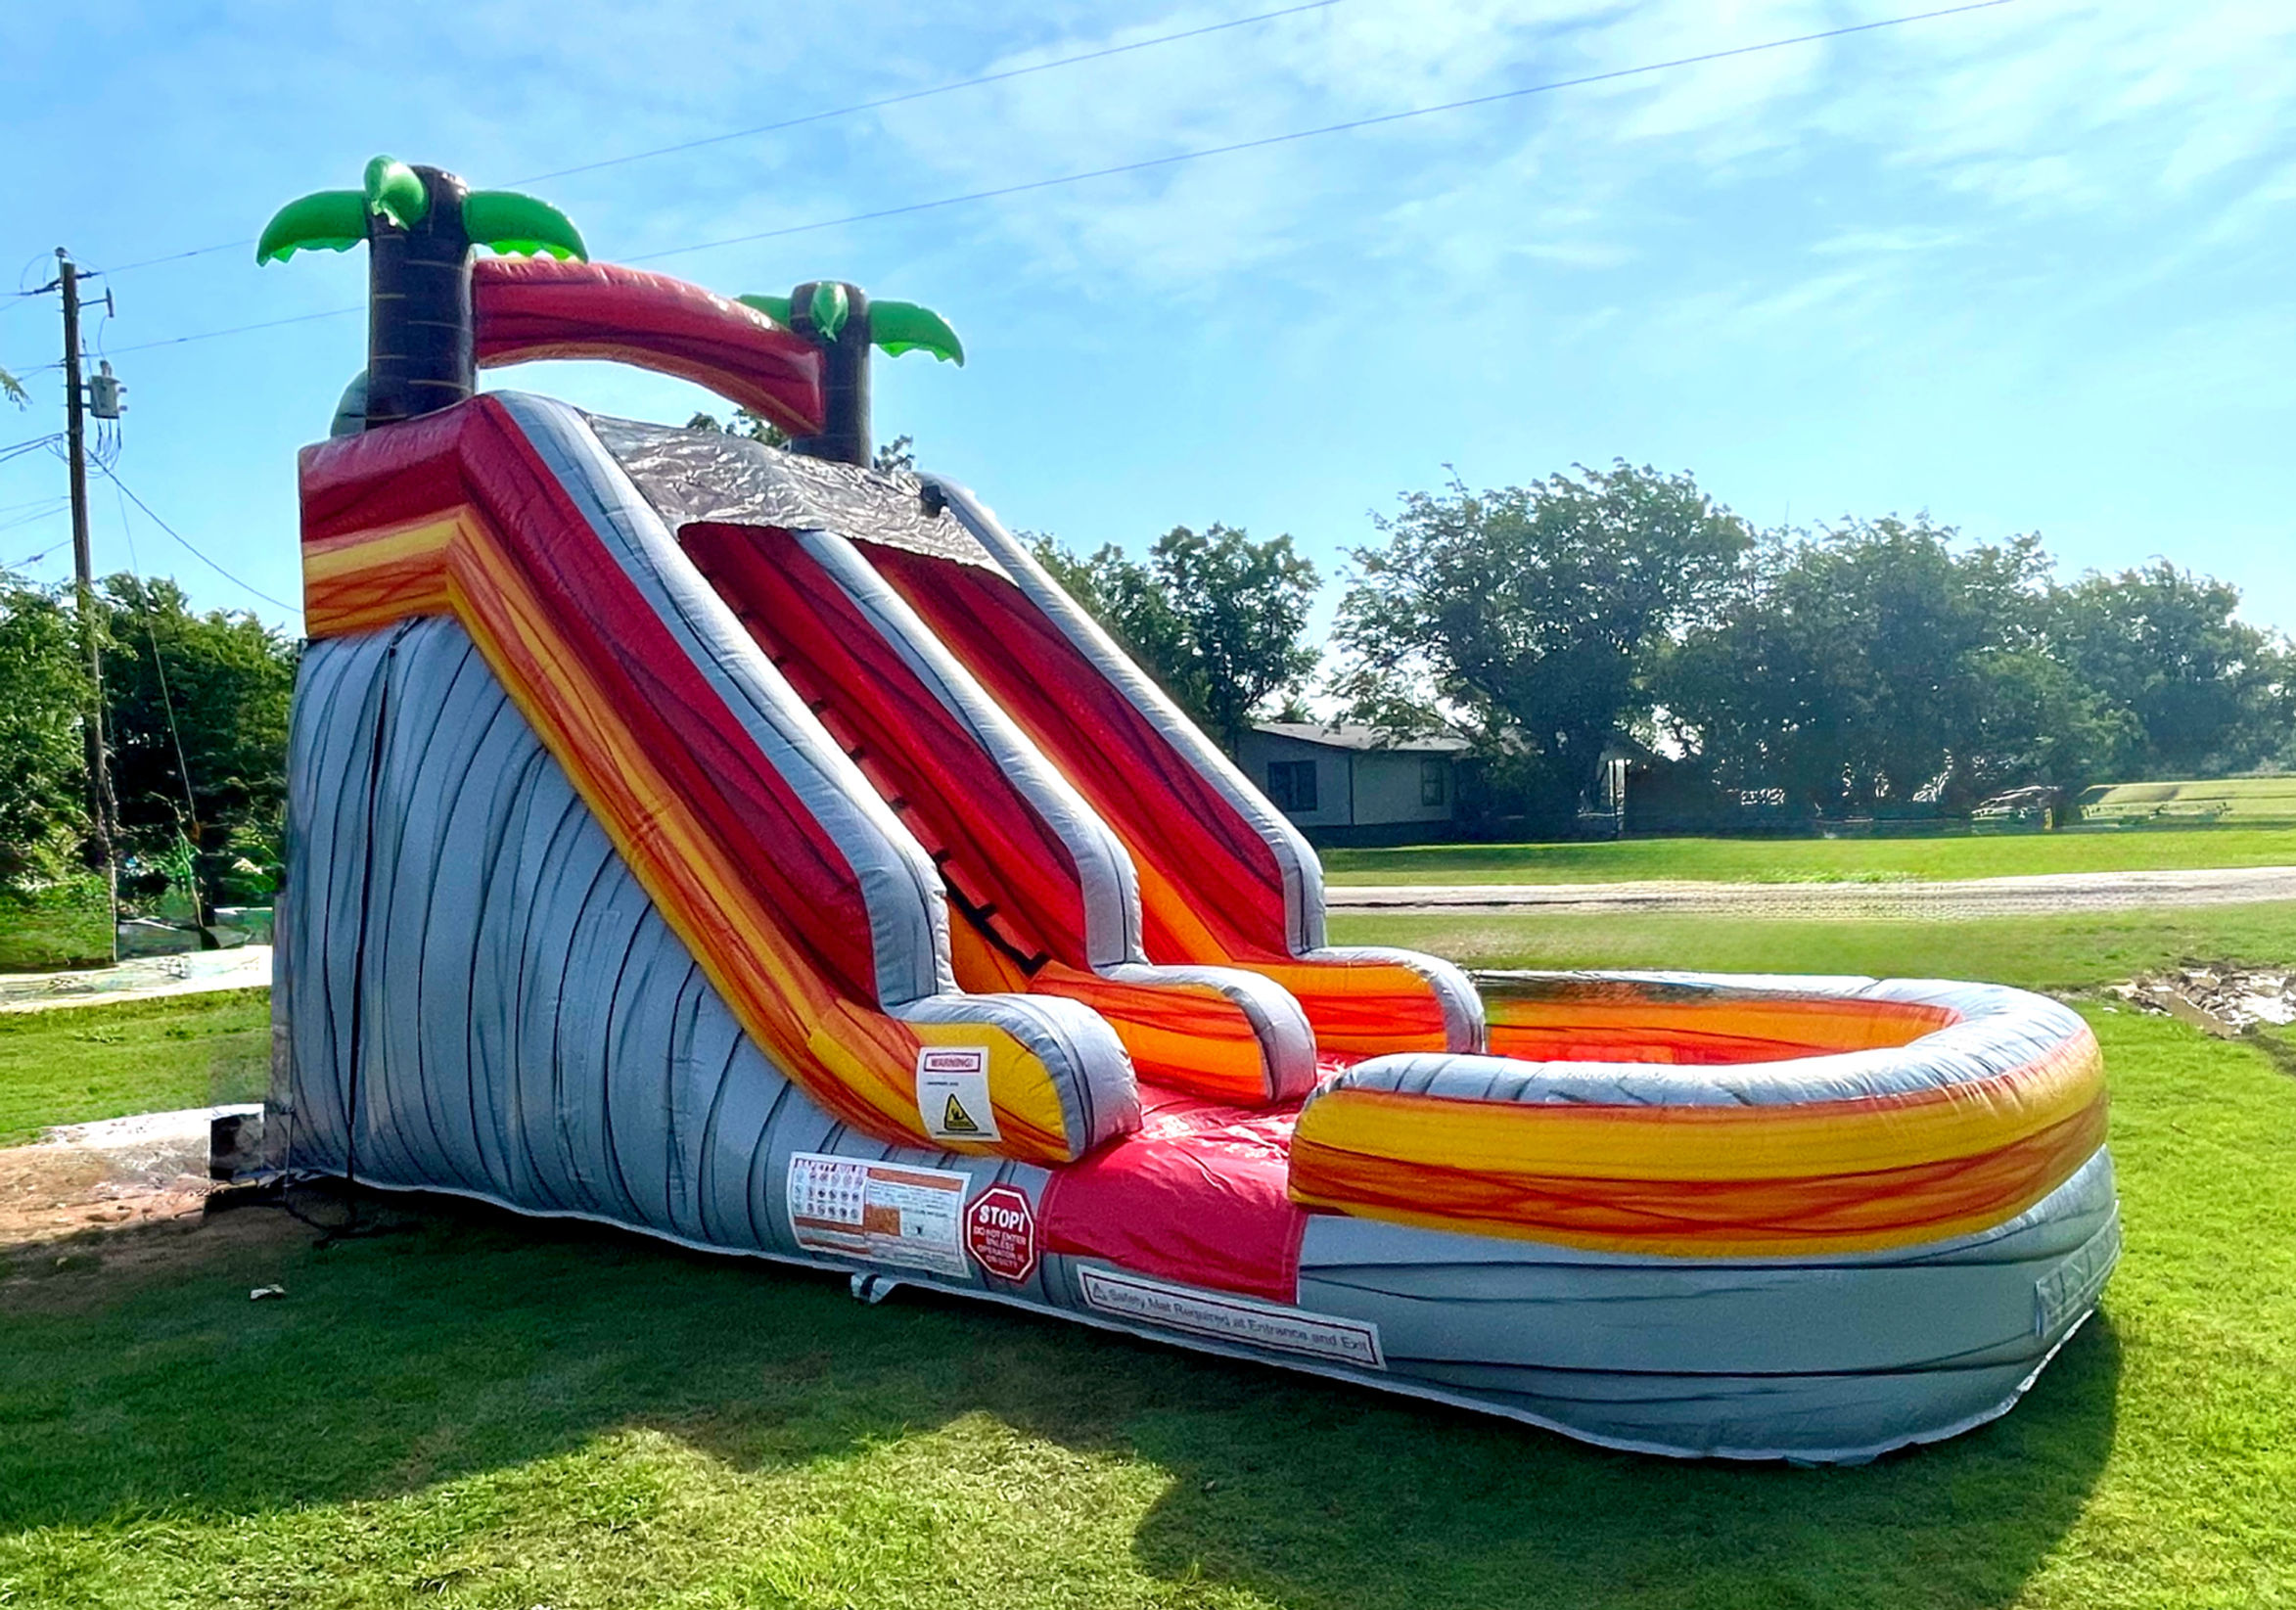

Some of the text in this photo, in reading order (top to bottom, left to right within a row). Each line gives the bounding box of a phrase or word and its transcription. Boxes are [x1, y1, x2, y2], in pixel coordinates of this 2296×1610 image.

[979, 1205, 1025, 1232] STOP!
[1108, 1288, 1145, 1310] Safety
[1148, 1297, 1171, 1312] Mat
[1247, 1320, 1308, 1341] Entrance
[1311, 1334, 1337, 1346] and
[1341, 1336, 1368, 1353] Exit
